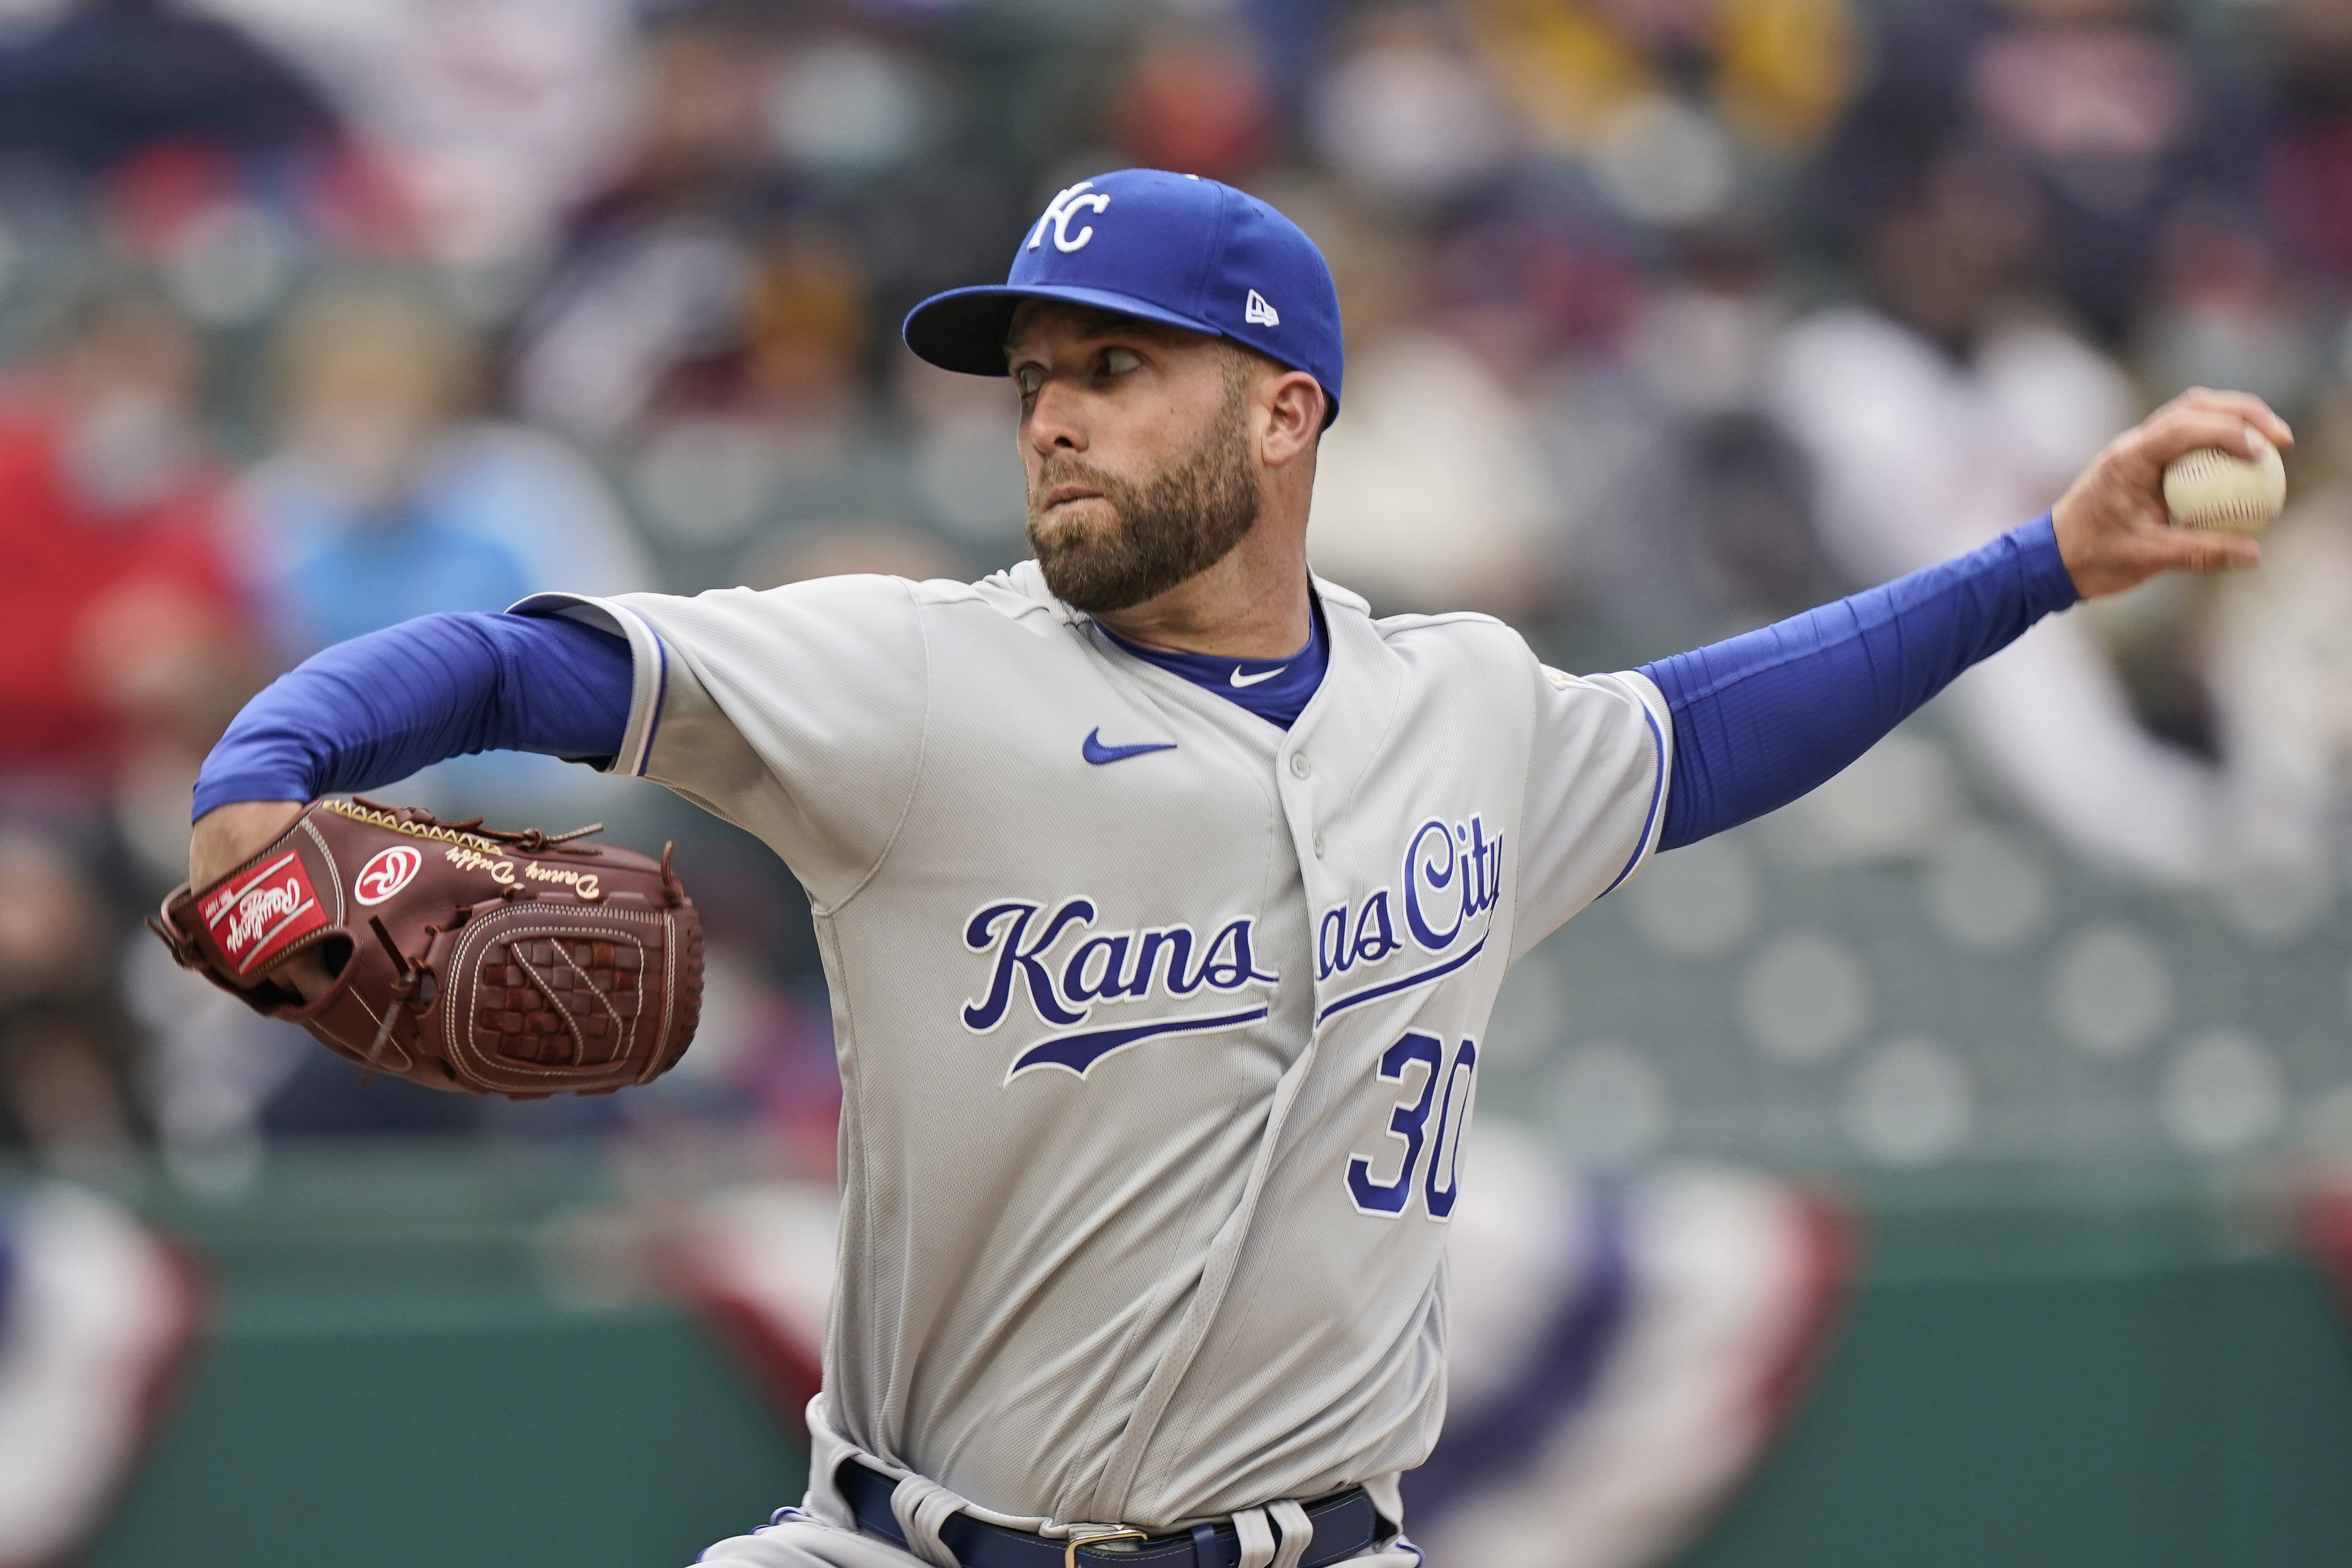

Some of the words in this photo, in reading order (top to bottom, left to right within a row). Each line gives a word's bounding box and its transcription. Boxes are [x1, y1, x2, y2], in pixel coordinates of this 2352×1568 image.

[1027, 181, 1110, 253] KC
[445, 846, 515, 884] Duffy
[525, 861, 599, 899] Danny
[1402, 811, 1504, 956] City
[226, 877, 300, 954] Rawlings
[1343, 1027, 1478, 1223] 30
